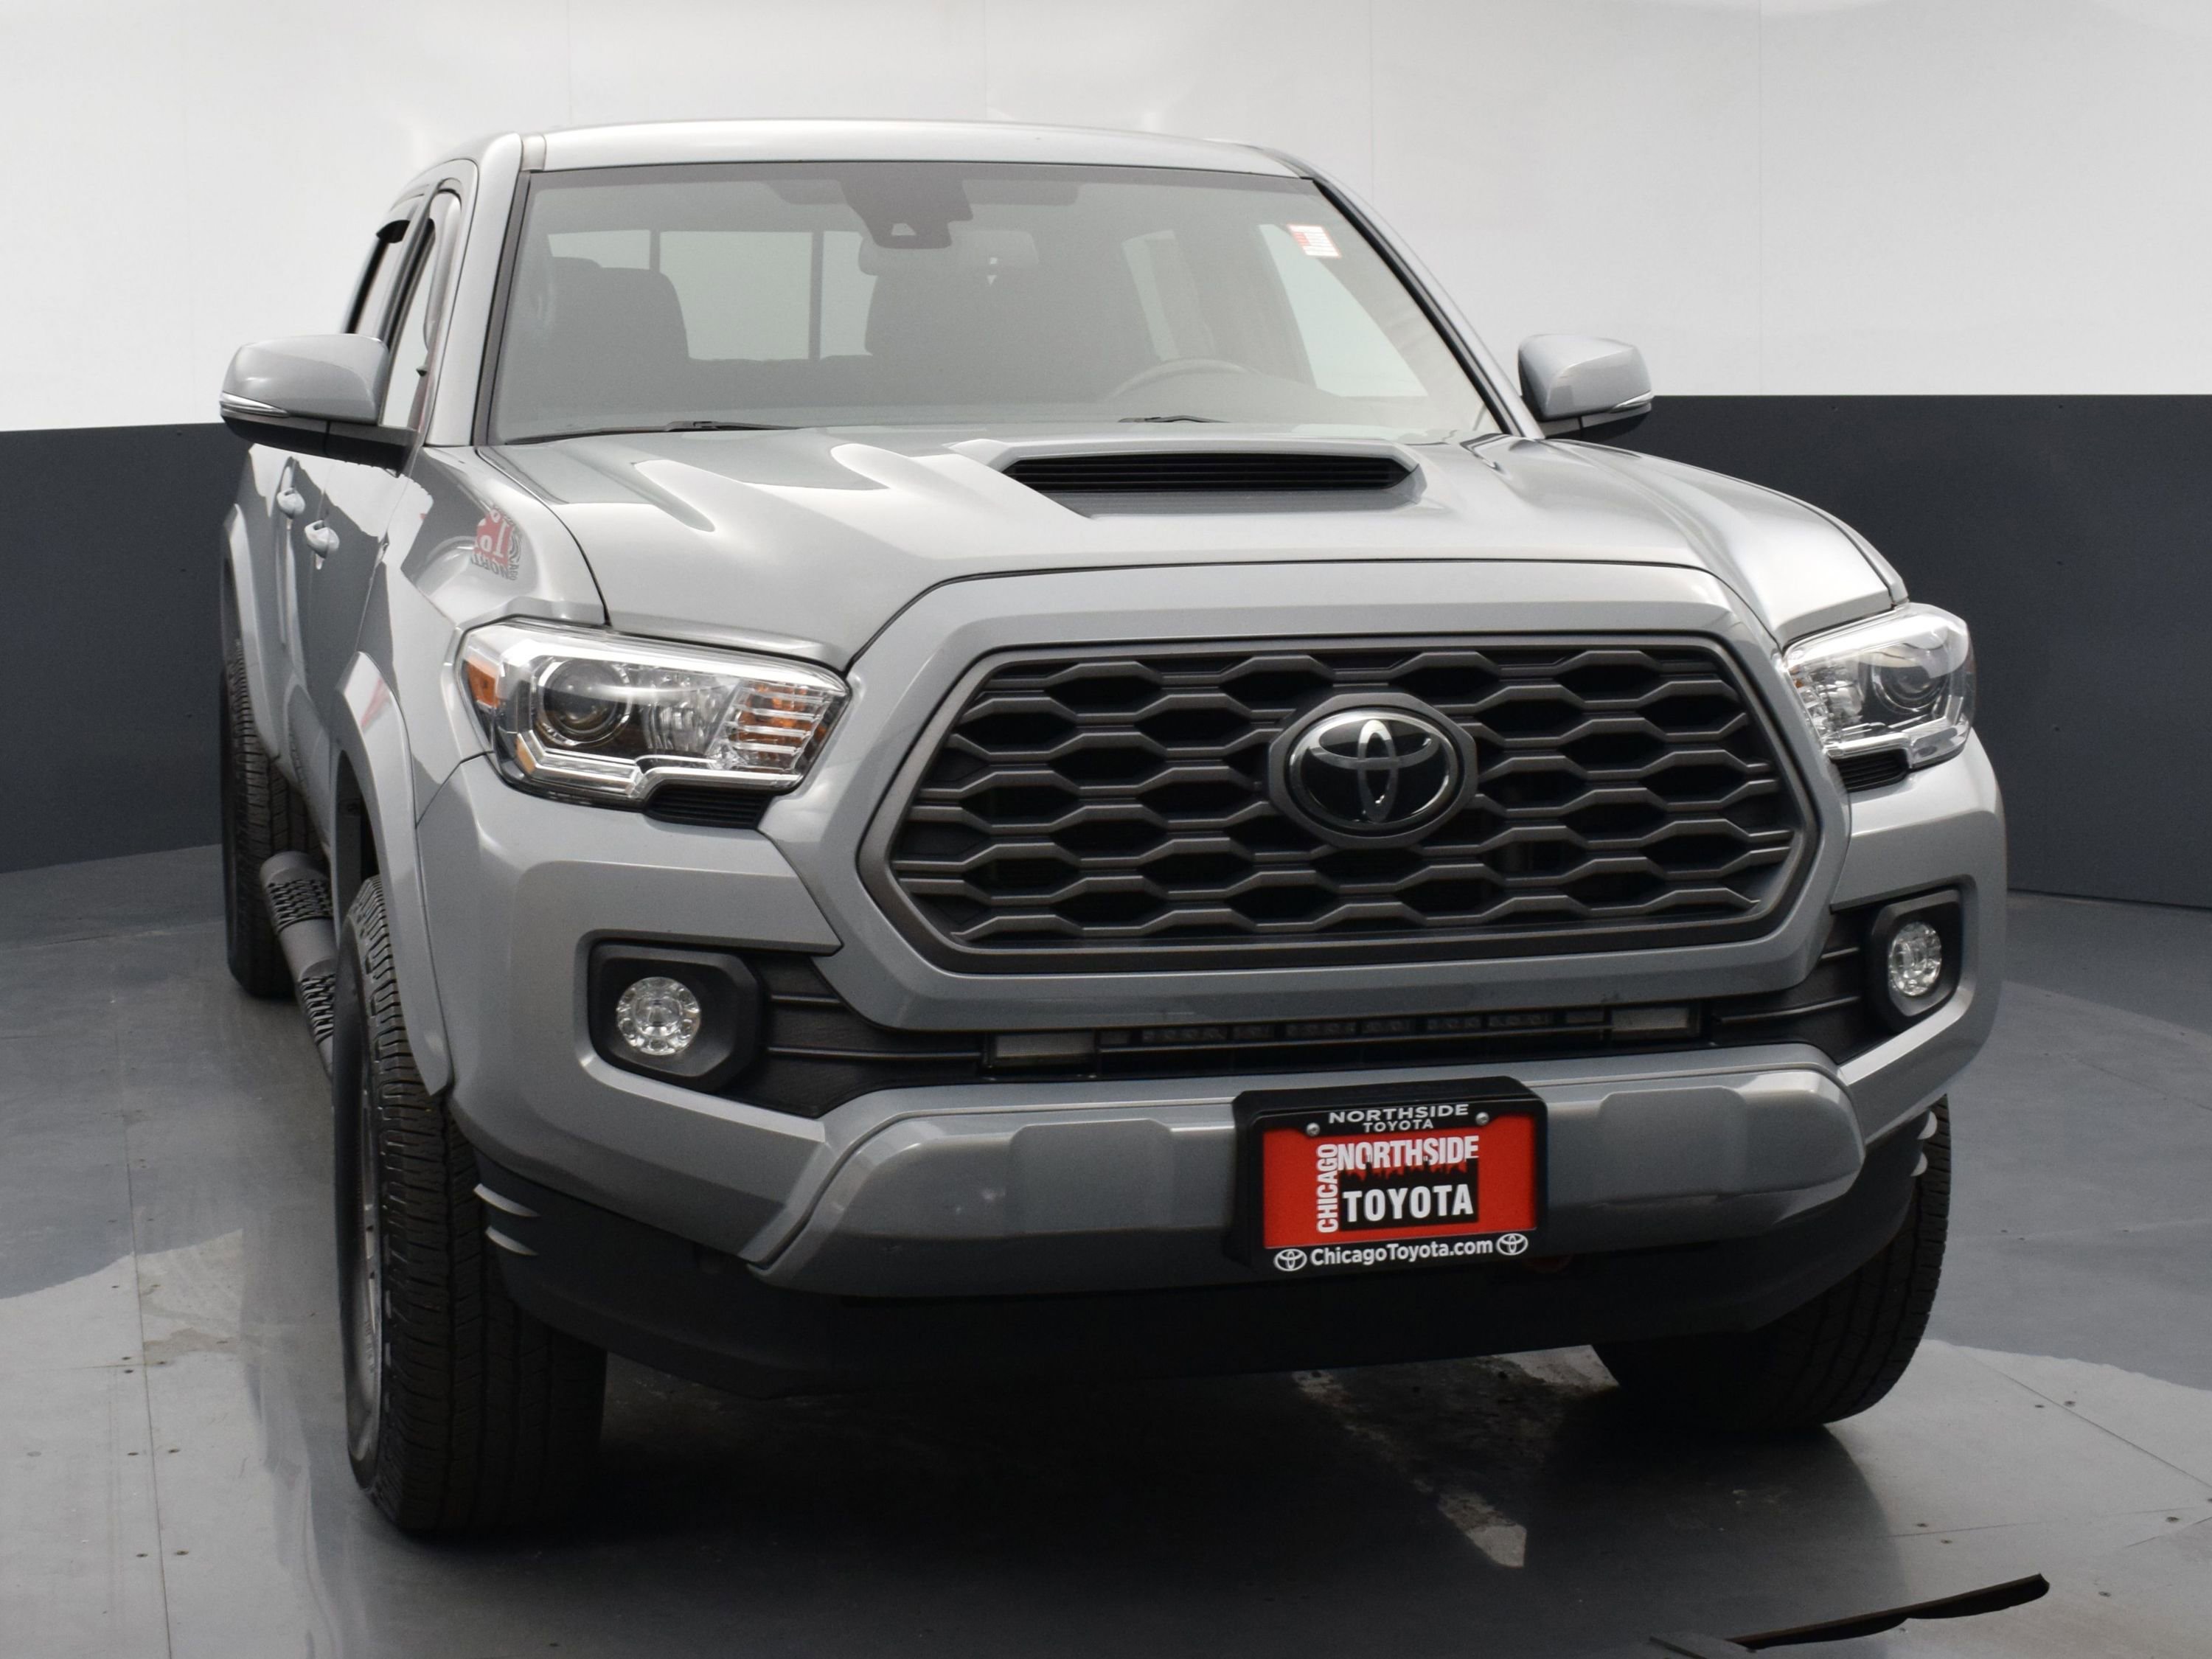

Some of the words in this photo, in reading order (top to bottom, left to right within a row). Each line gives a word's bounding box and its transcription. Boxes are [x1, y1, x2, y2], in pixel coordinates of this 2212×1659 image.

[1329, 1104, 1468, 1123] NORTHSIDE
[1363, 1119, 1433, 1133] TOYOTA
[1338, 1135, 1479, 1171] NORTHSIDE
[1318, 1144, 1338, 1233] CHICAGO
[1343, 1184, 1474, 1222] TOYOTA
[1311, 1239, 1493, 1266] ChicagoToyota.com
